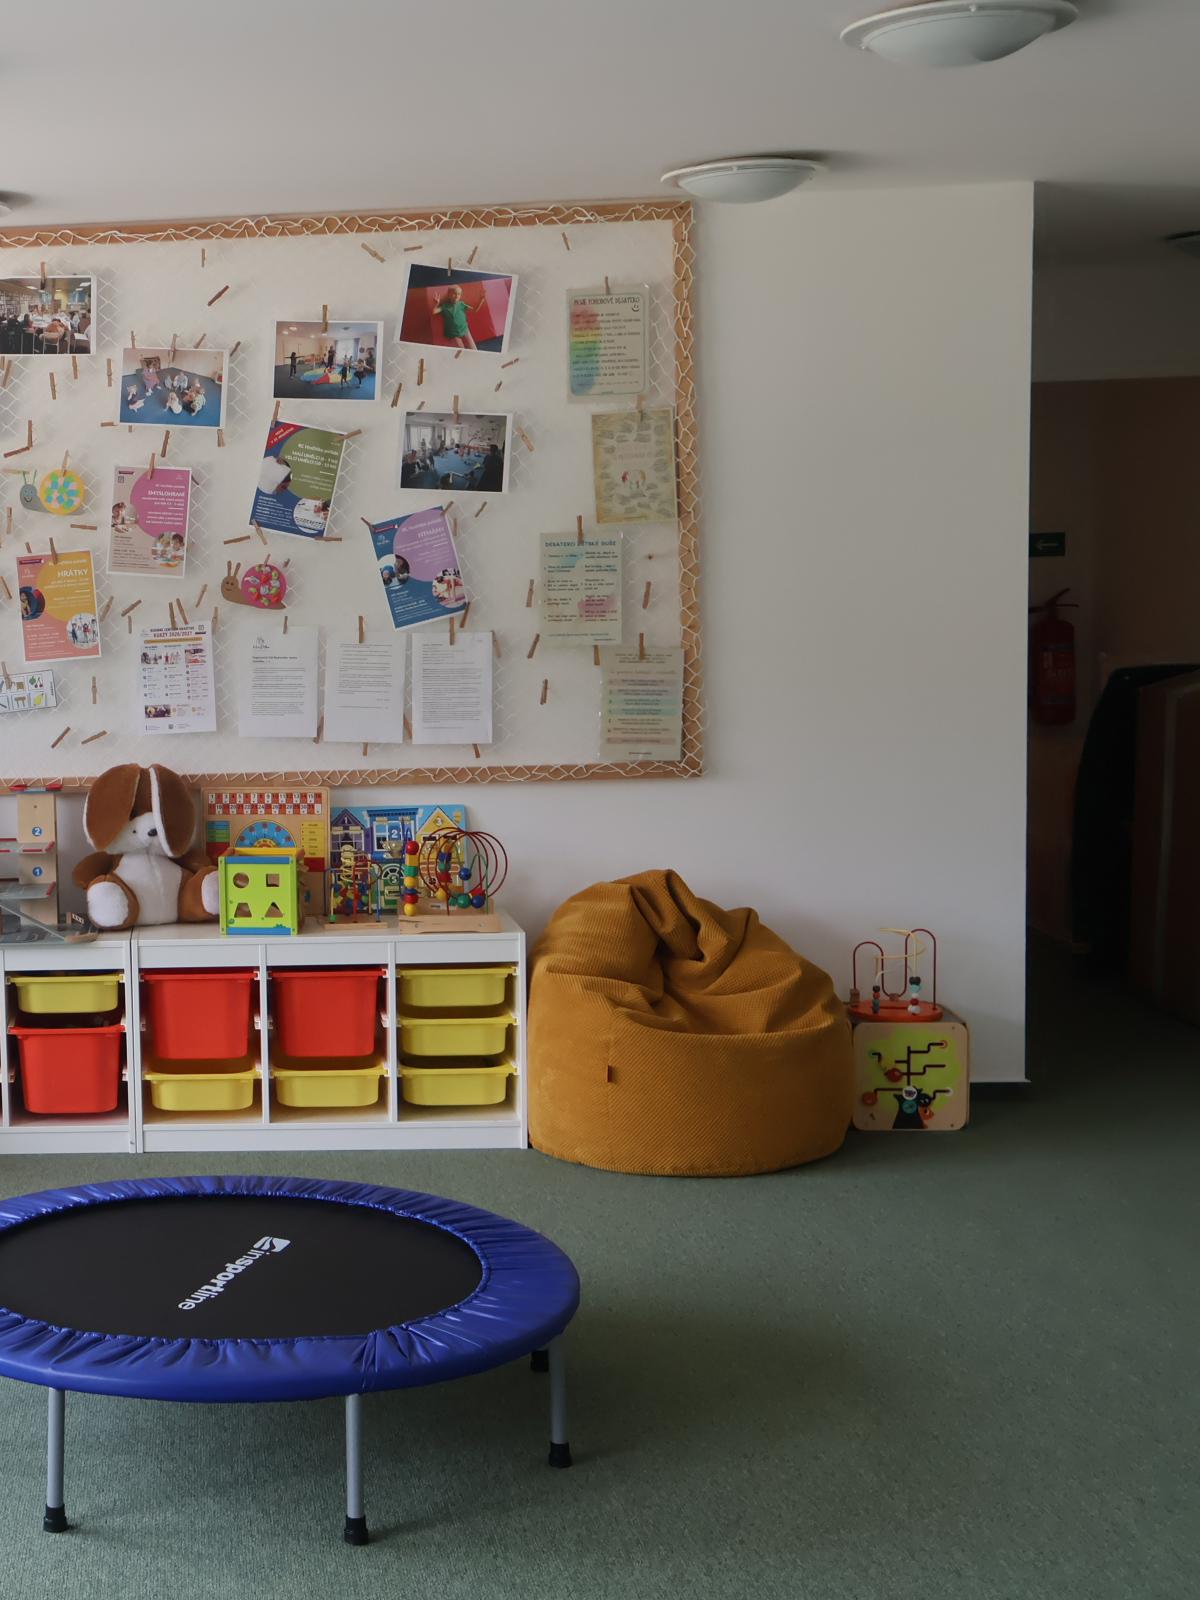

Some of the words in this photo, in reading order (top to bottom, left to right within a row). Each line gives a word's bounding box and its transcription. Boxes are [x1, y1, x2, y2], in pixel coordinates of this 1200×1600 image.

[57, 567, 89, 578] HRÁTKY
[391, 829, 398, 838] 2
[178, 1249, 270, 1310] insportline
